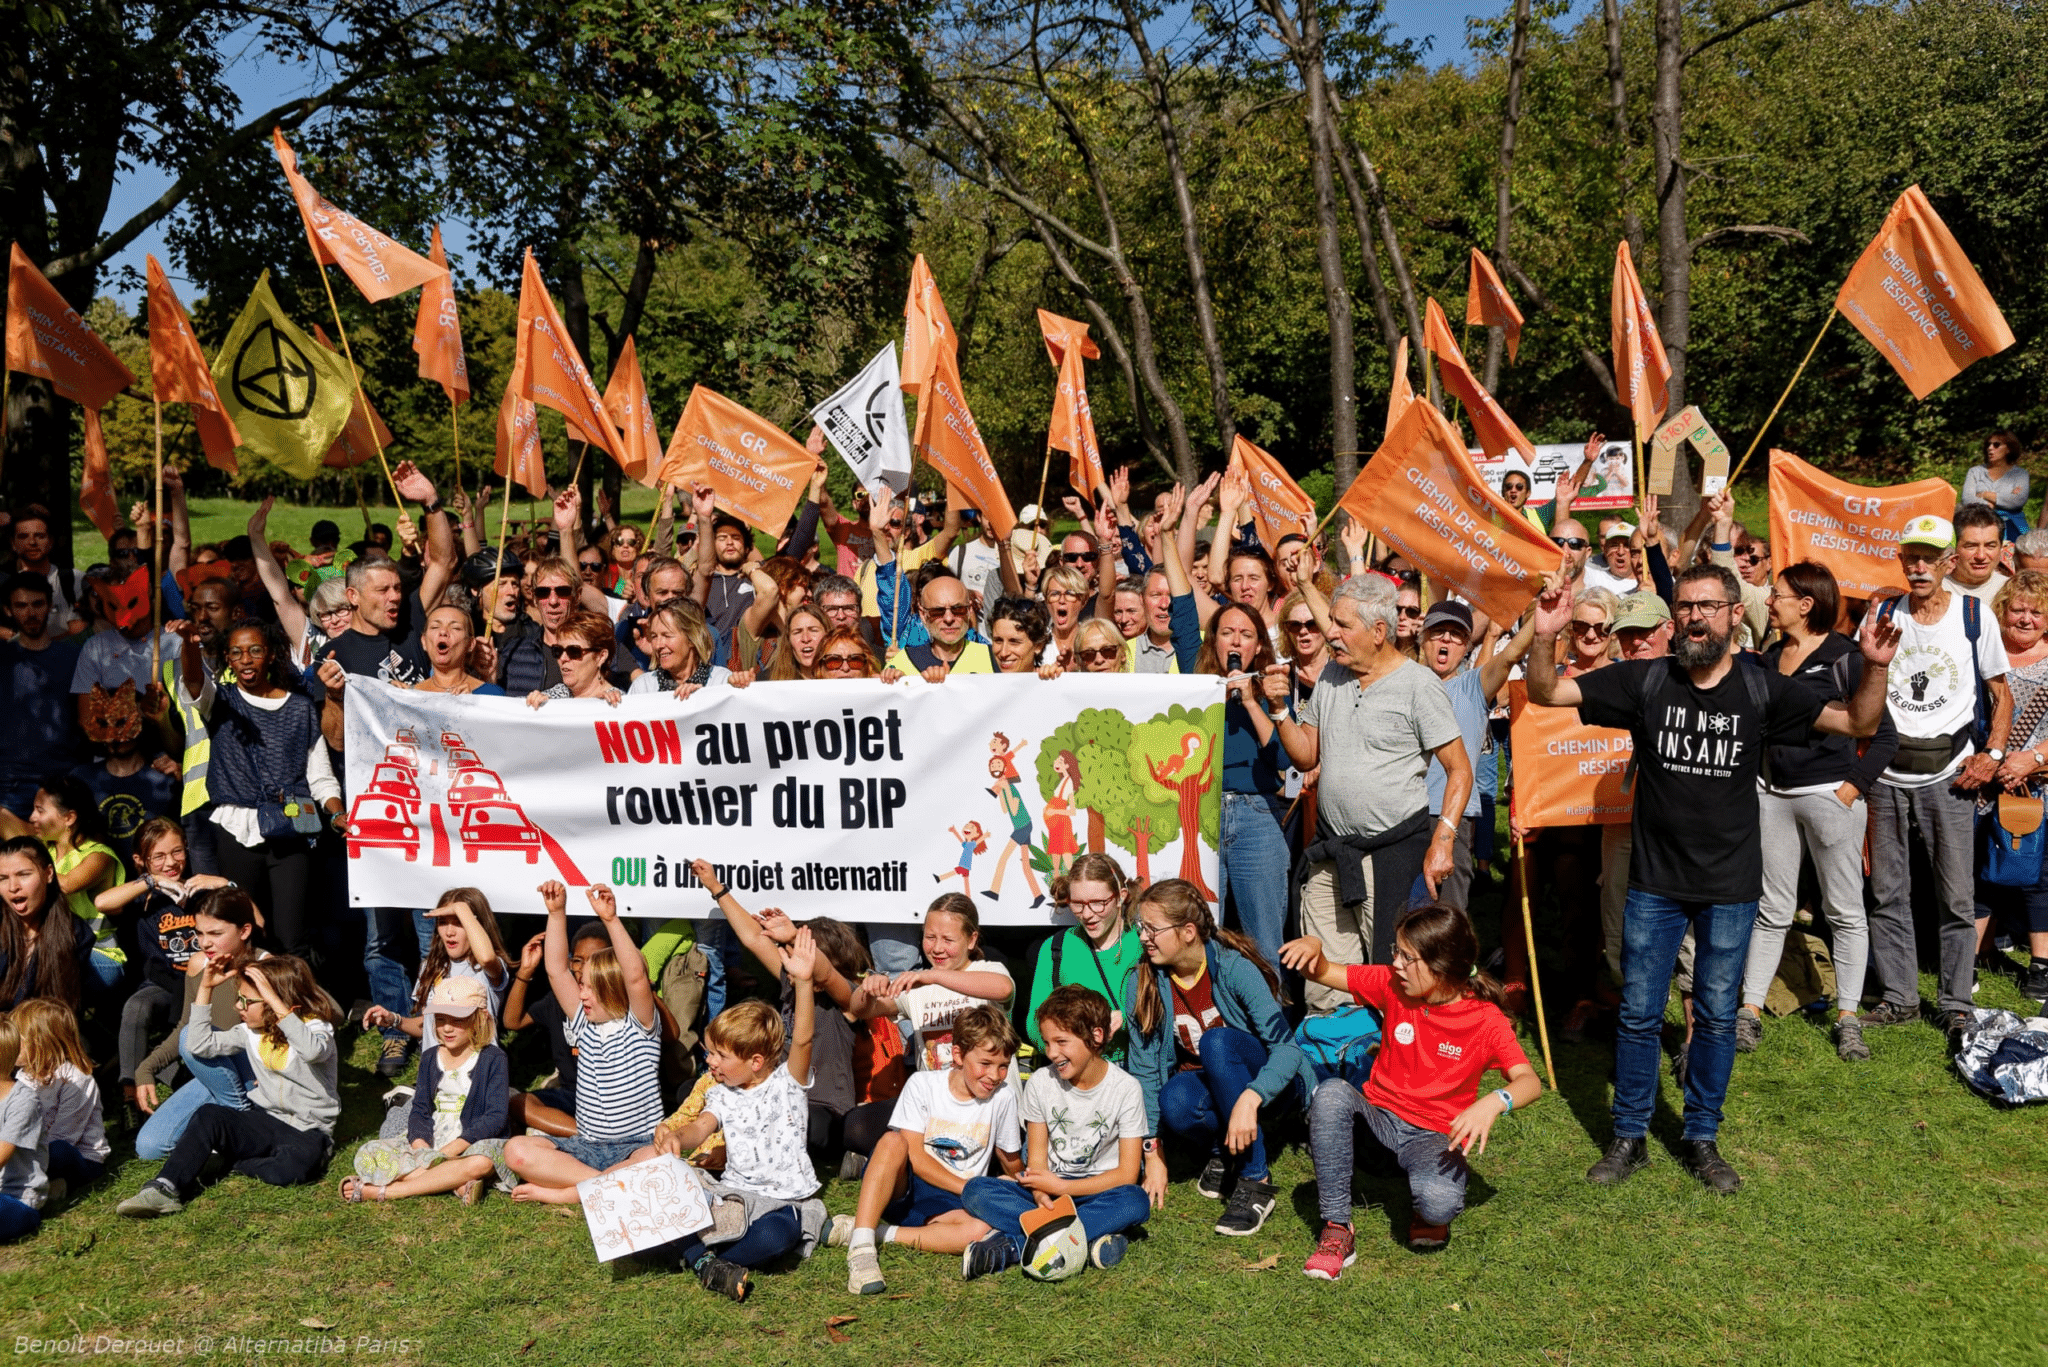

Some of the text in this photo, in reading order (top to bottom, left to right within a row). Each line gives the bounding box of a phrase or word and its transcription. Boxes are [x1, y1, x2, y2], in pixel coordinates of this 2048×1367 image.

[1880, 275, 1941, 340] RÉSISTANCE
[1882, 248, 1975, 351] CHEMIN DE GRANDE
[935, 381, 976, 428] CHEMIN
[739, 431, 769, 456] GR
[1660, 412, 1693, 444] STOP
[697, 434, 795, 491] CHEMIN DE GRANDE
[943, 411, 999, 484] RÉSISTANCE
[708, 456, 769, 494] RÉSISTANCE
[1260, 471, 1283, 493] GR
[1269, 500, 1299, 524] GRANDE
[1843, 494, 1883, 517] GR
[1406, 466, 1529, 582] CHEMIN DE GRANDE
[1414, 502, 1491, 575] RÉSISTANCE
[1787, 508, 1900, 543] CHEMIN DE GRA
[1810, 532, 1897, 560] RÉSISTANCE
[1919, 644, 1941, 656] LES
[1940, 651, 1959, 691] TERRES
[1665, 705, 1686, 729] I'M
[1890, 690, 1948, 713] DE GONESSE
[594, 708, 904, 769] NON au projet
[1547, 737, 1634, 756] CHEMIN DE
[1657, 730, 1744, 767] INSANE
[1578, 757, 1632, 776] RÉSIST
[1662, 762, 1732, 778] MY MOTHER HAD ME TESTED
[606, 776, 907, 829] routier du BIP
[612, 857, 647, 887] OUI
[653, 855, 668, 888] à
[711, 860, 785, 893] projet
[791, 861, 908, 892] alternatif
[1438, 1041, 1462, 1056] aigo
